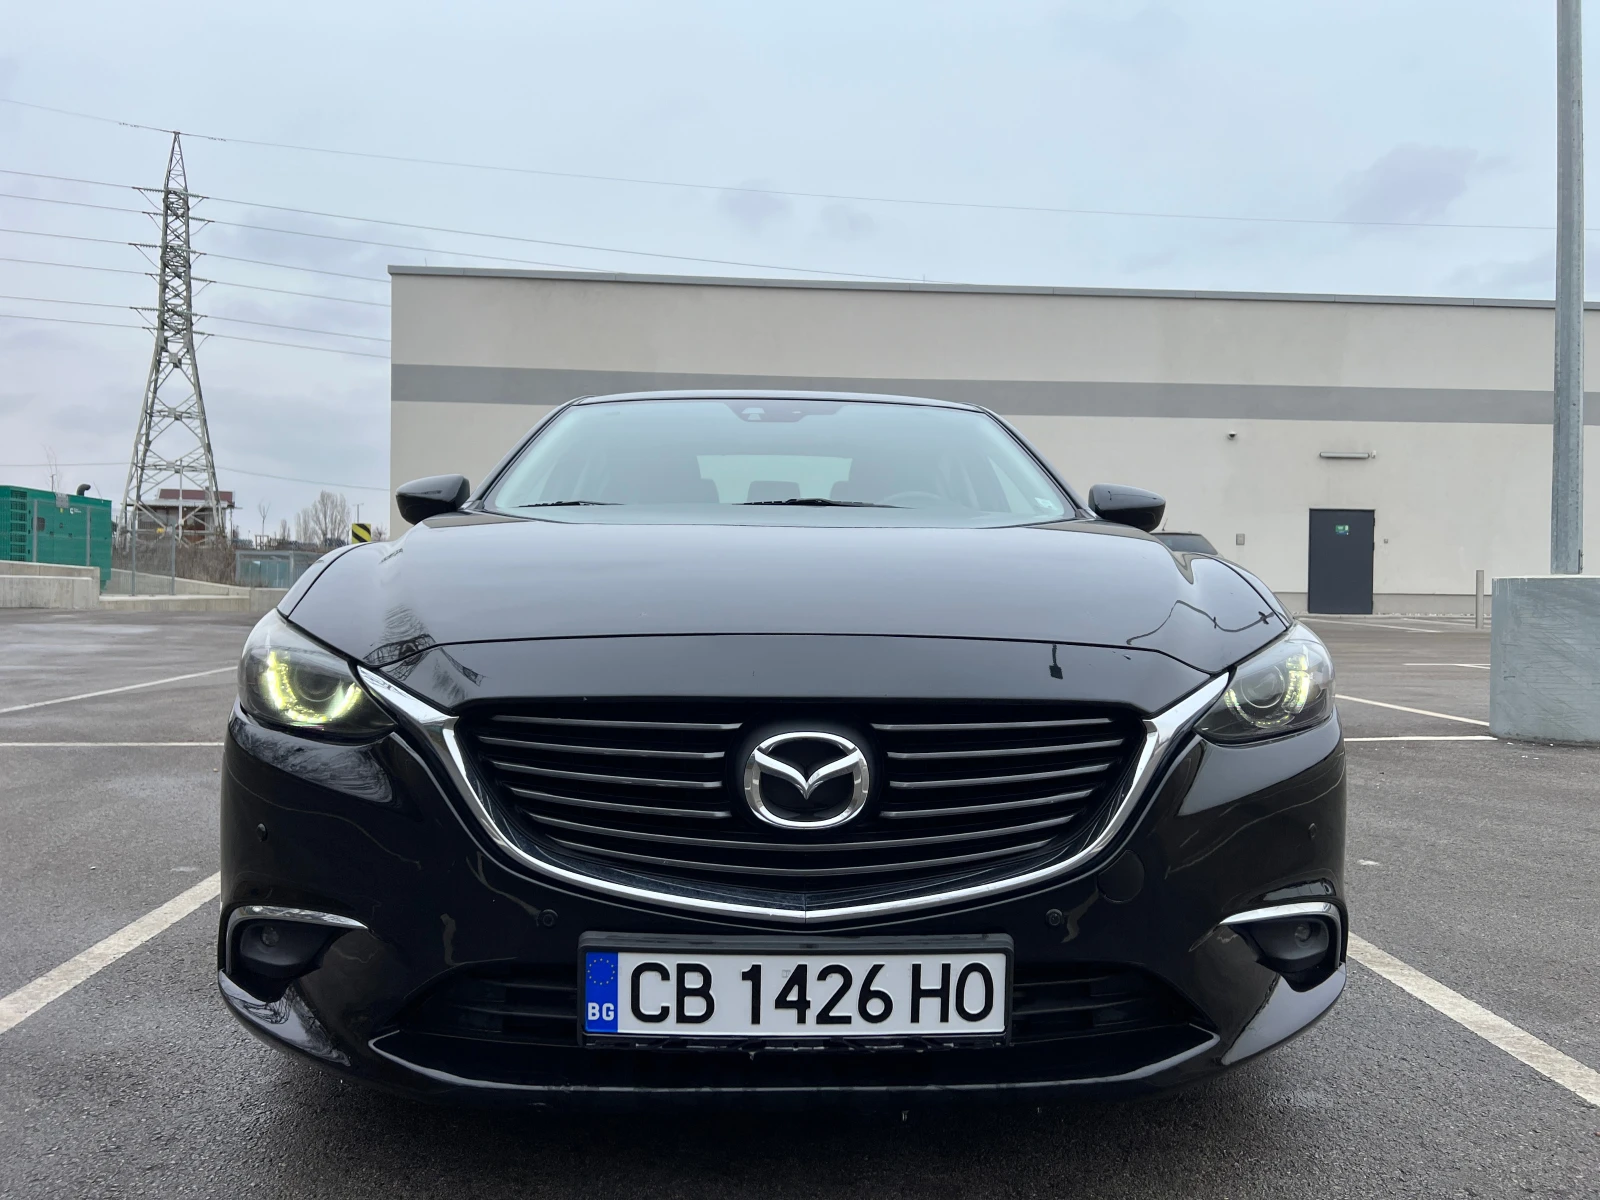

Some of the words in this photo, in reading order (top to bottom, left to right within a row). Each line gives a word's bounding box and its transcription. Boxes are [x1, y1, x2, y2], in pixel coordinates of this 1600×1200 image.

[588, 1002, 615, 1021] BG
[630, 962, 715, 1025] CB
[741, 963, 894, 1025] 1426
[910, 962, 994, 1024] HO
